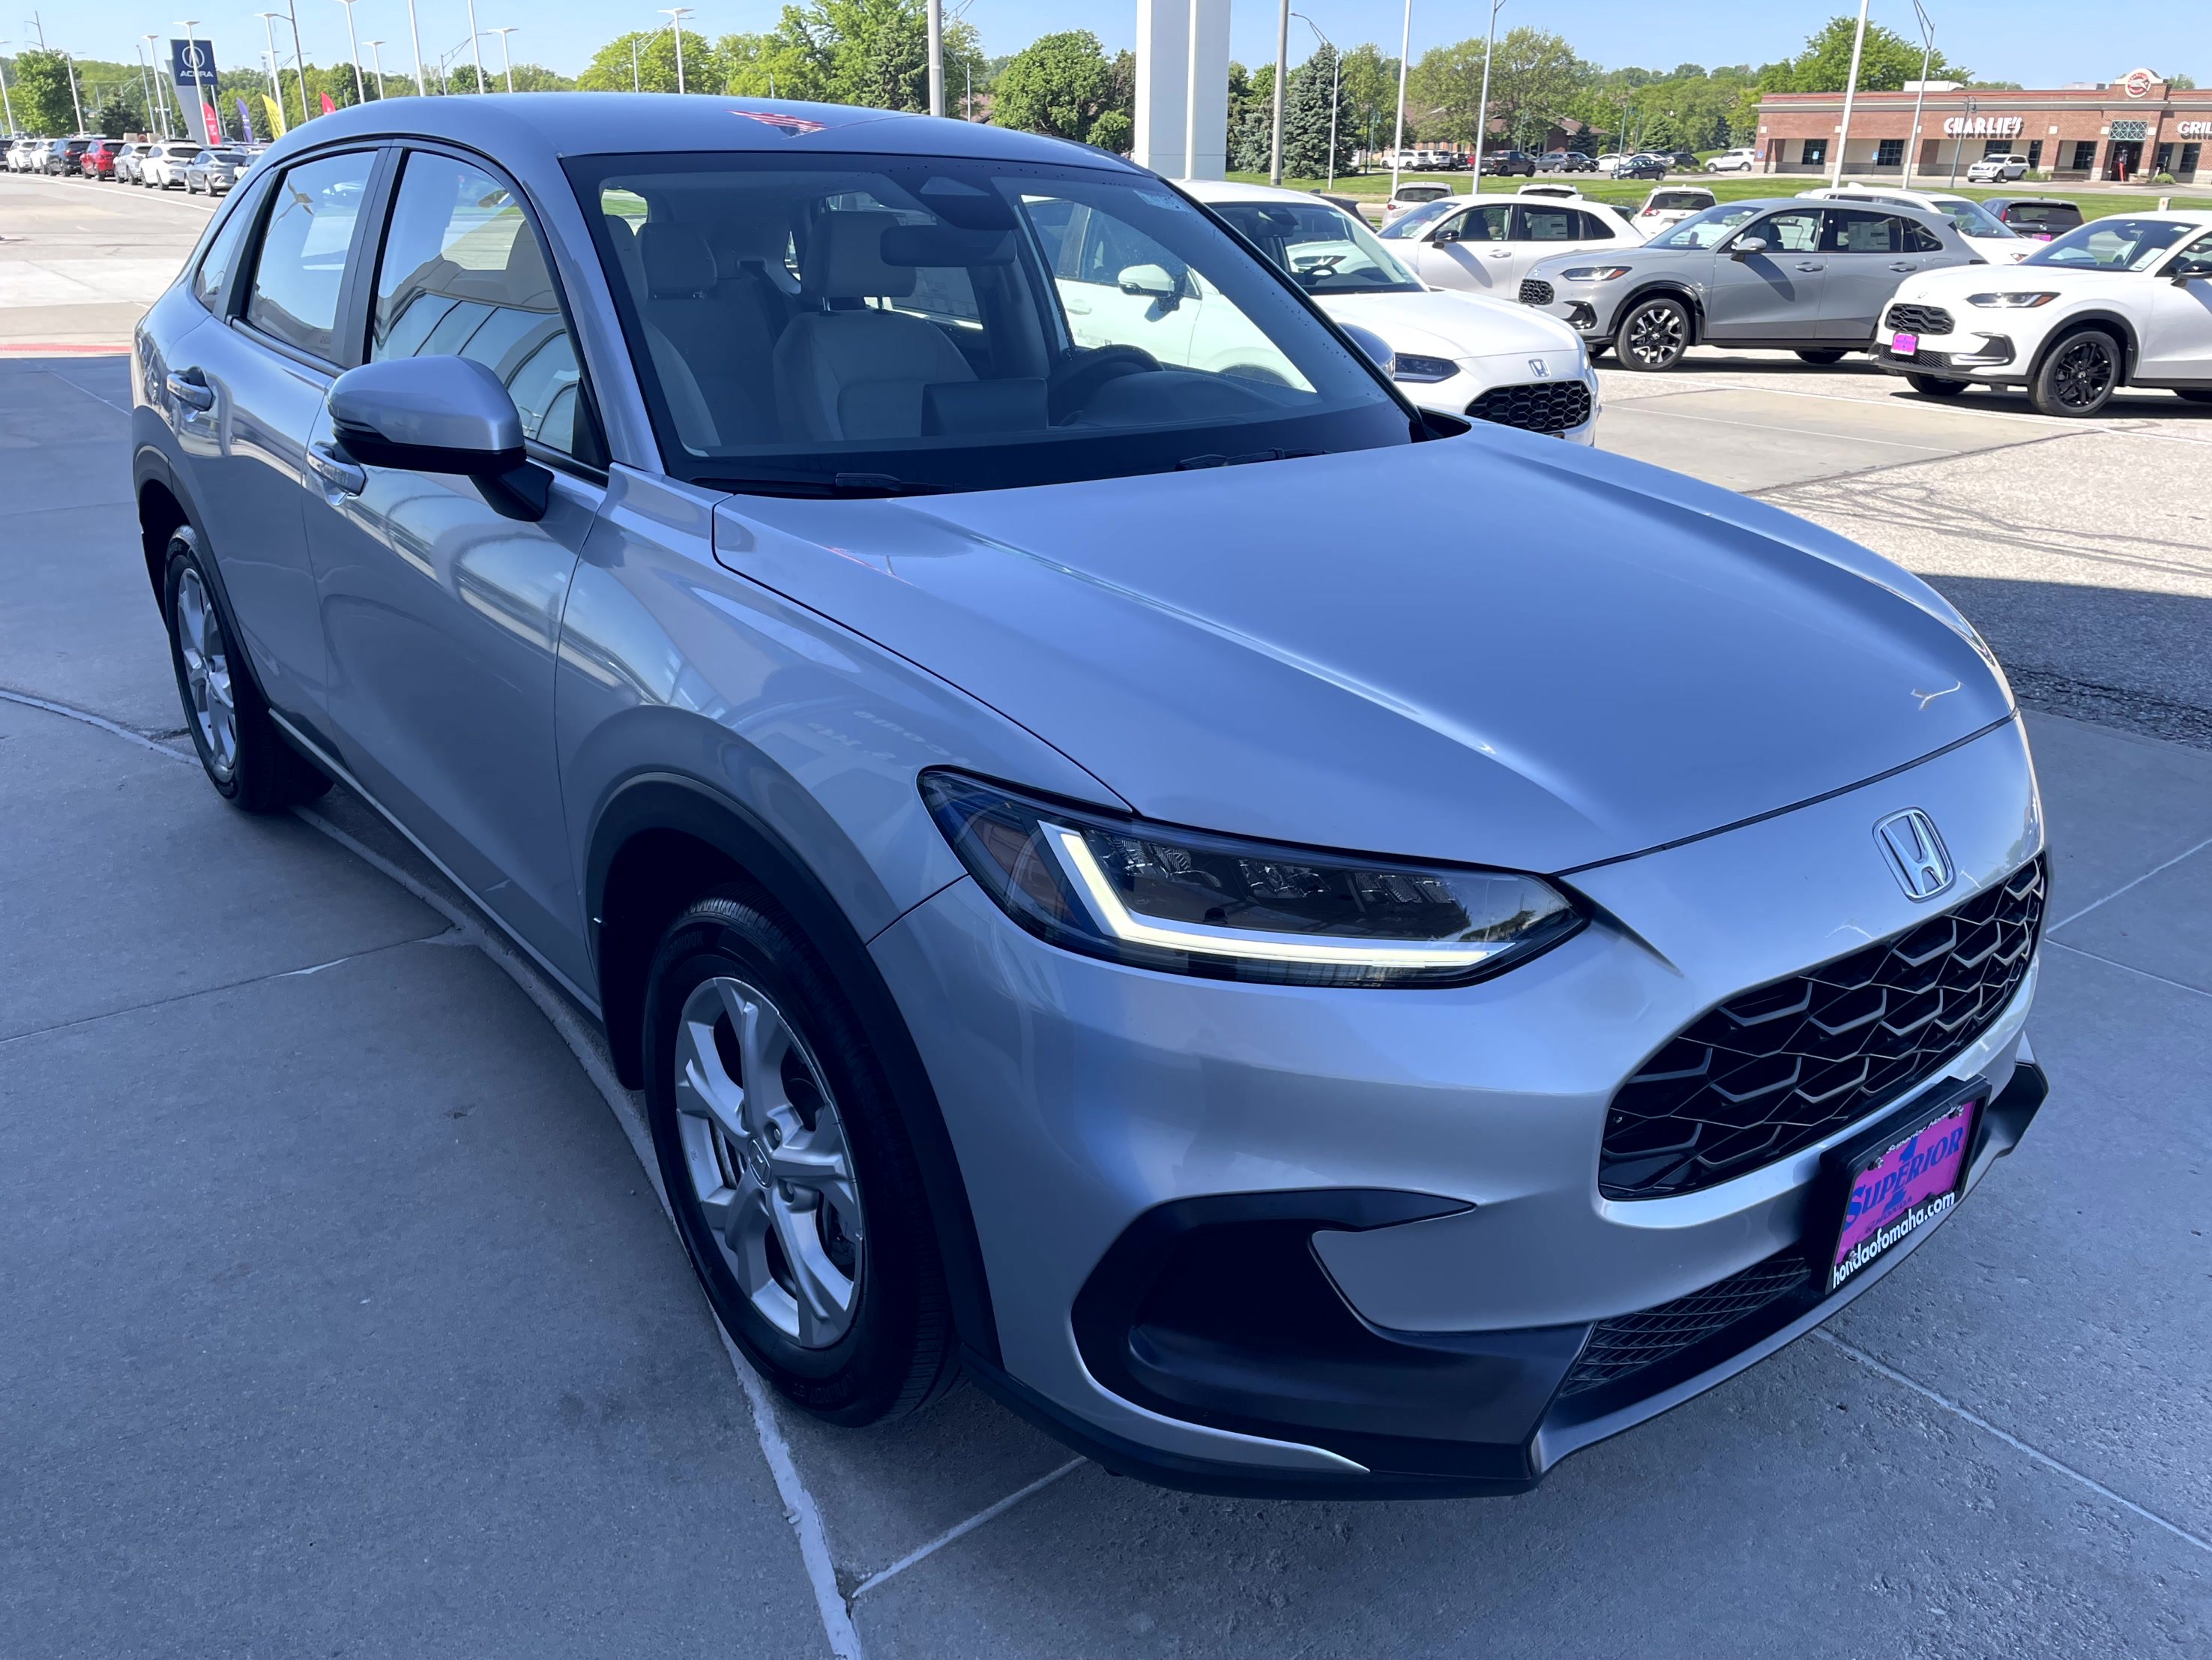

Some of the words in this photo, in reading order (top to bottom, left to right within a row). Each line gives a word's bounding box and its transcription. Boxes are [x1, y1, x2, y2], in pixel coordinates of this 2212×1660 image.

[1944, 117, 2022, 134] CHARLIE'S
[1844, 1127, 1963, 1232] SUPERIOR
[1833, 1191, 1955, 1289] hondaofomaha.com
